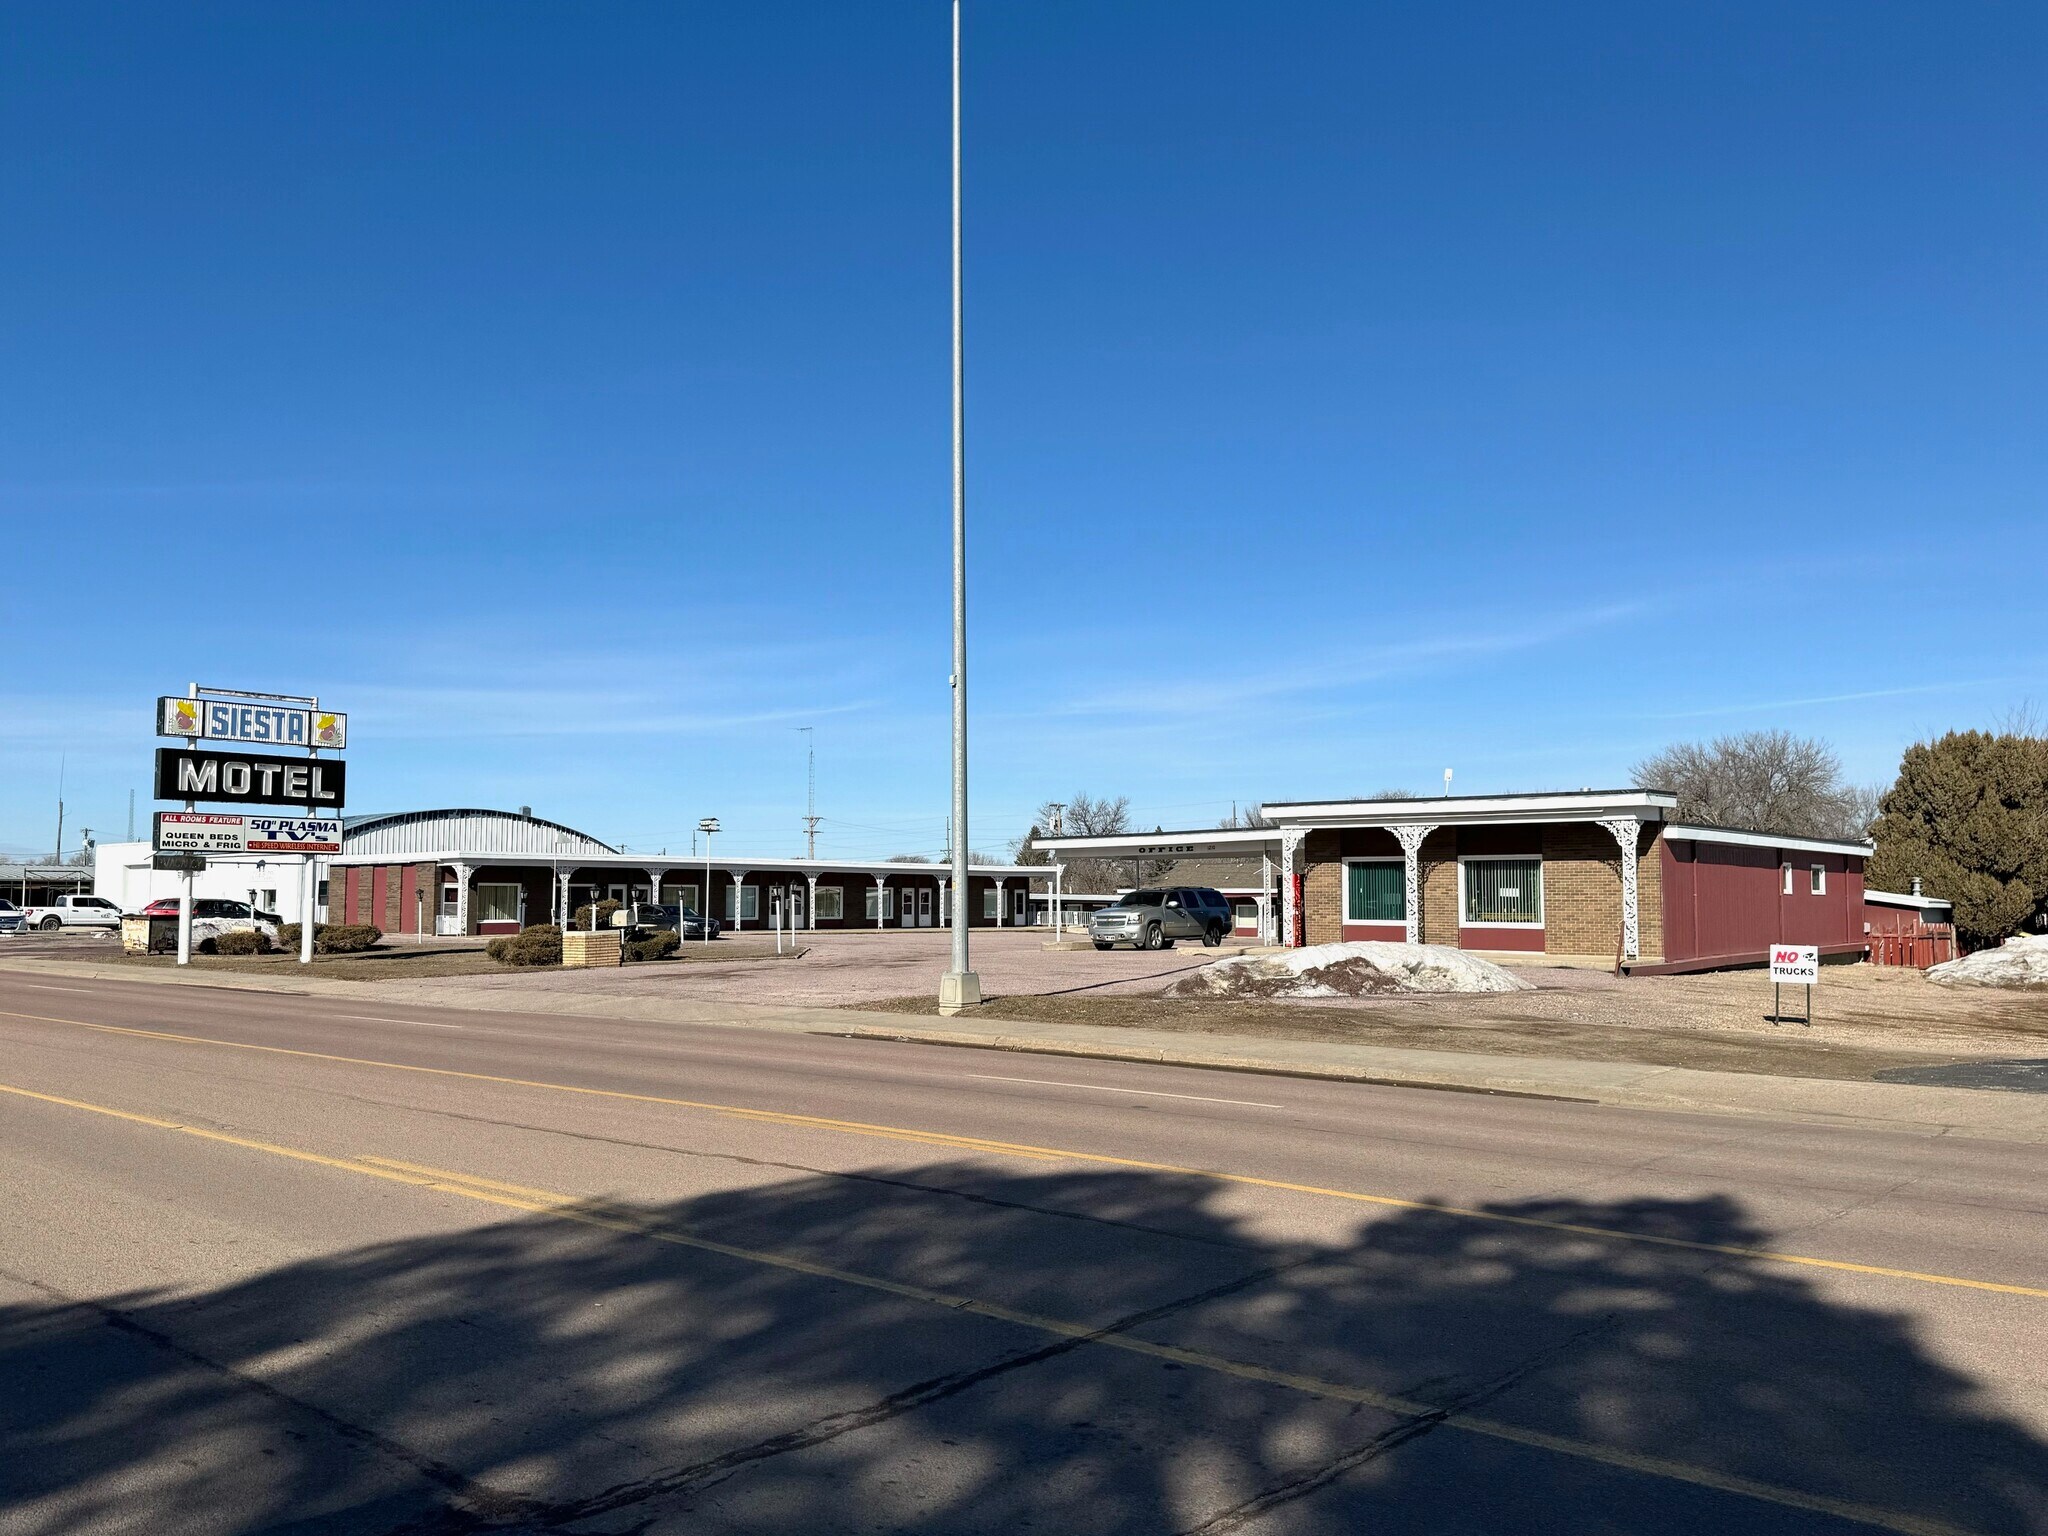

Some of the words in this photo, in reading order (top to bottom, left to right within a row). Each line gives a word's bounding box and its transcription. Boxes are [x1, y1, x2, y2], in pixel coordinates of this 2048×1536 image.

[212, 706, 303, 742] SIESTA
[178, 758, 335, 800] MOTEL
[278, 820, 338, 832] PLASMA
[165, 832, 204, 840] QUEEN
[210, 833, 238, 841] BEDS
[261, 831, 328, 842] TV's
[162, 840, 198, 848] MICRO
[216, 841, 241, 849] FRIG
[280, 843, 306, 851] WIRELESS
[306, 843, 335, 851] INTERNET
[1138, 845, 1194, 853] OFFICE
[1775, 951, 1799, 963] NO
[1773, 966, 1814, 976] TRUCKS
